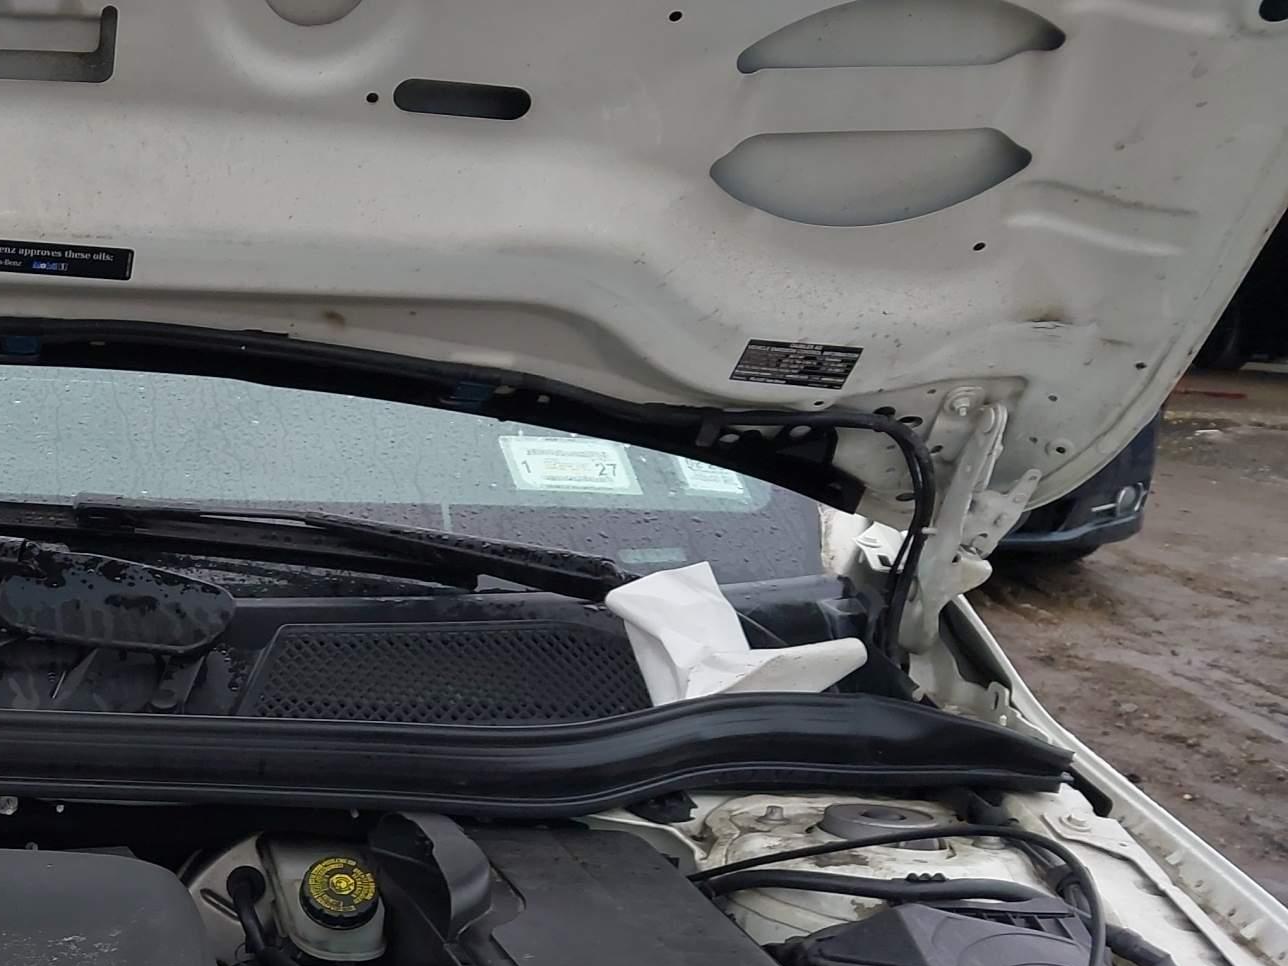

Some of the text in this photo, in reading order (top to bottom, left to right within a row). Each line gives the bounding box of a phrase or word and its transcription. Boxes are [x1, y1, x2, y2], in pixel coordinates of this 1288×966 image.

[18, 247, 62, 257] approves
[64, 249, 91, 260] these
[92, 251, 115, 262] oils:
[594, 462, 617, 477] 27
